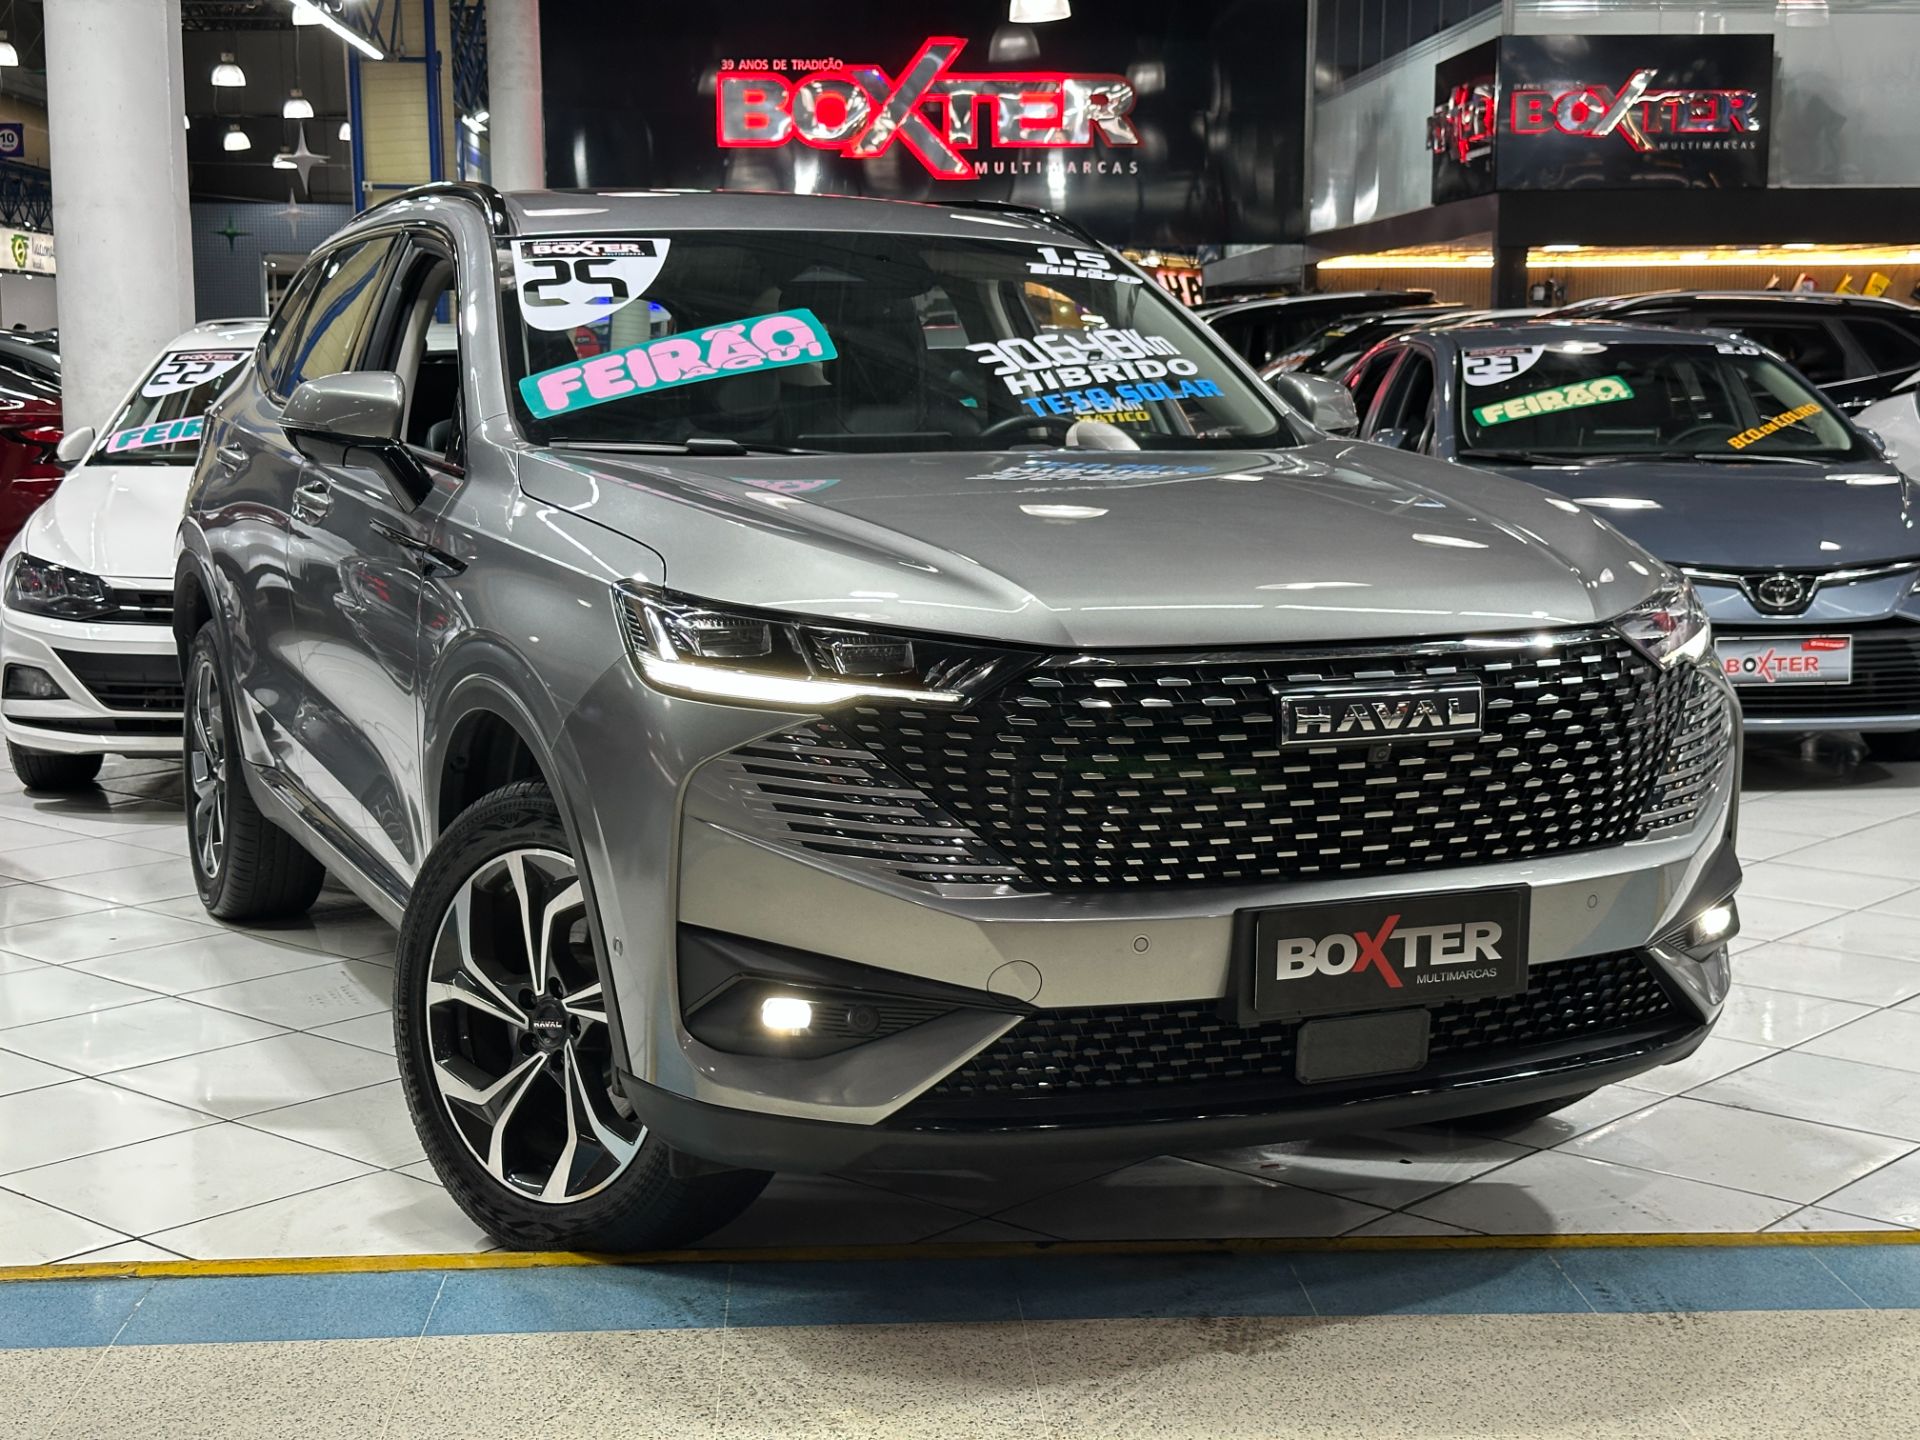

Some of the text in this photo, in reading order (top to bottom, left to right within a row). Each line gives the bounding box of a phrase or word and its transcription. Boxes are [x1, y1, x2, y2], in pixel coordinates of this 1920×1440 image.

[720, 57, 843, 71] 39 ANOS DE TRADIÇÃO
[716, 36, 1144, 180] BOXTER
[1510, 68, 1760, 152] BOXTER
[1658, 141, 1756, 151] MULTIMARCAS
[532, 240, 642, 256] BOXTER
[1037, 247, 1111, 270] 1.5
[523, 259, 630, 307] 25
[1026, 262, 1144, 285] Turbo
[1715, 344, 1760, 356] 2.0
[150, 362, 215, 386] 22
[537, 316, 816, 411] FEIRÃO
[1467, 355, 1519, 376] 23
[1116, 378, 1225, 404] SOLAR
[1481, 378, 1624, 424] FEIRÃO
[1723, 648, 1819, 683] BOXTER
[1295, 697, 1476, 735] HAVAL
[500, 811, 520, 825] SUV
[1276, 914, 1502, 988] BOXTER
[1416, 967, 1497, 985] MULTIMARCAS
